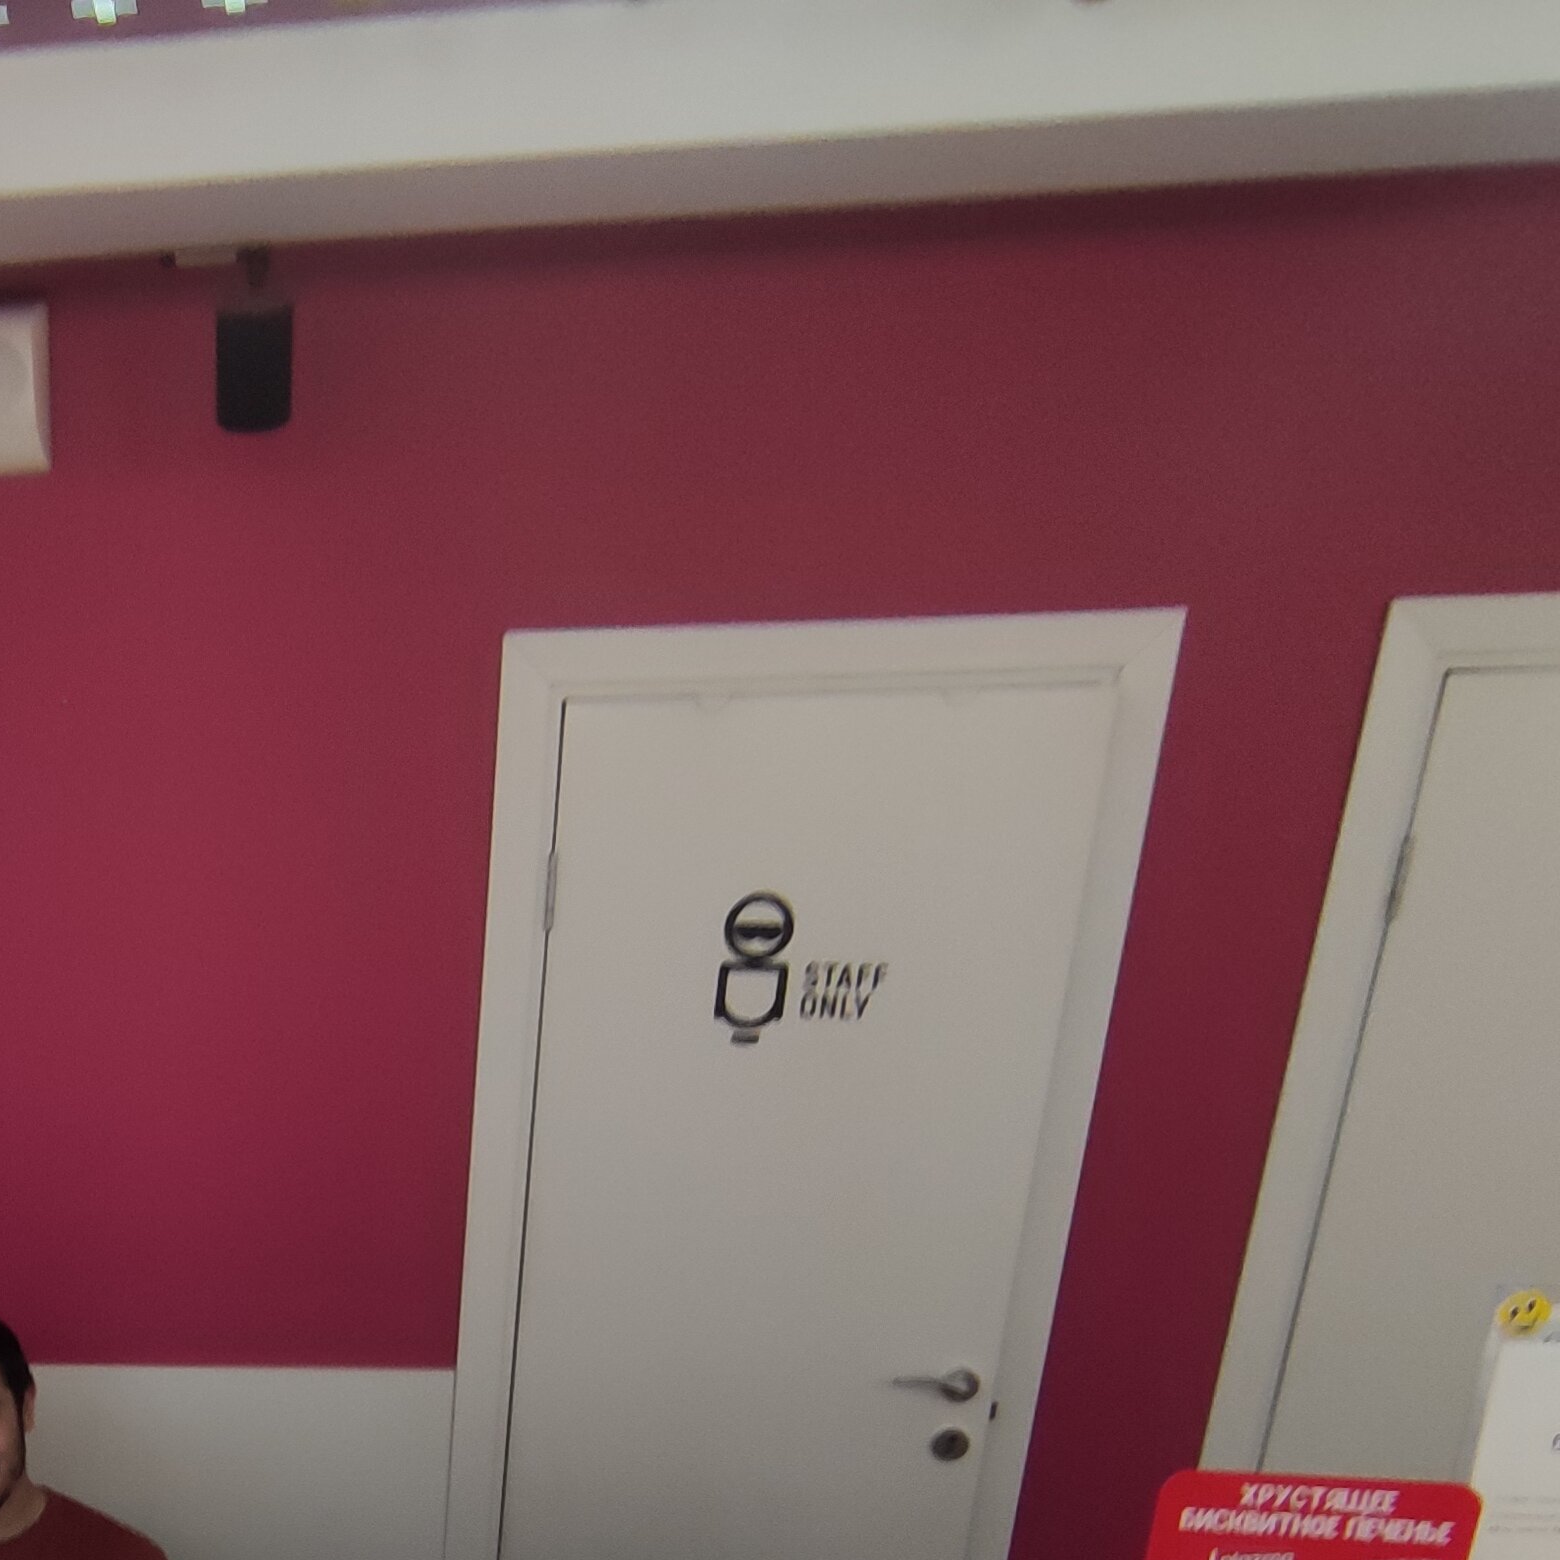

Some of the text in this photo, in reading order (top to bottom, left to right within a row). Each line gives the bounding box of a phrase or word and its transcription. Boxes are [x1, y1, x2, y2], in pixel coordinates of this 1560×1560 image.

[803, 960, 889, 990] STAFF
[799, 989, 873, 1020] ONLY
[1240, 1482, 1400, 1514] ХРУСТЯЩЕЕ
[1178, 1506, 1456, 1547] БИСКВИТНОЕ ПЕЧЕНЬЕ
